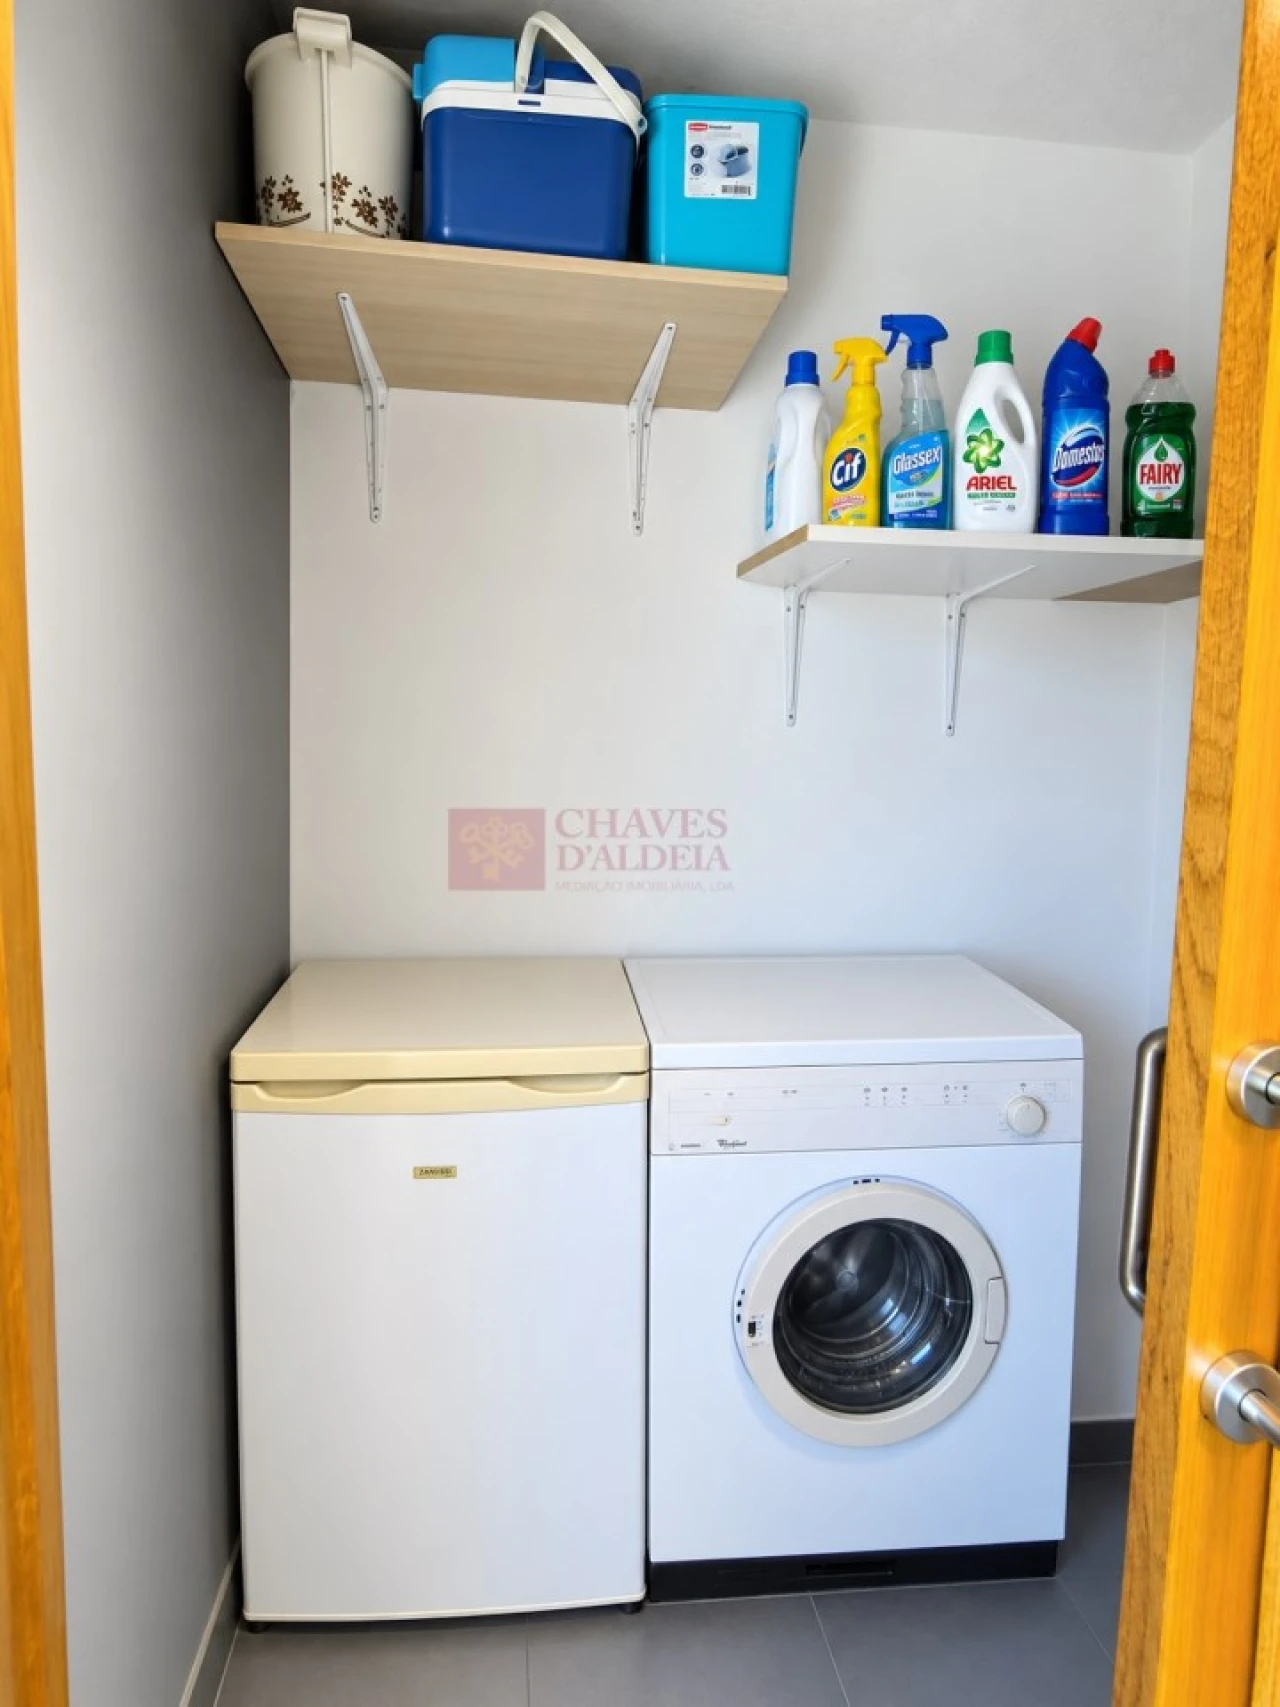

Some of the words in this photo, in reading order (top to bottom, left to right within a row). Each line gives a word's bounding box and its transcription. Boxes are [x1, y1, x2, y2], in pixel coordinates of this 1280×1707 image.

[833, 451, 862, 486] Cif
[893, 446, 940, 475] Glassex
[966, 475, 1017, 491] ARIEL
[1139, 463, 1182, 485] FAIRY
